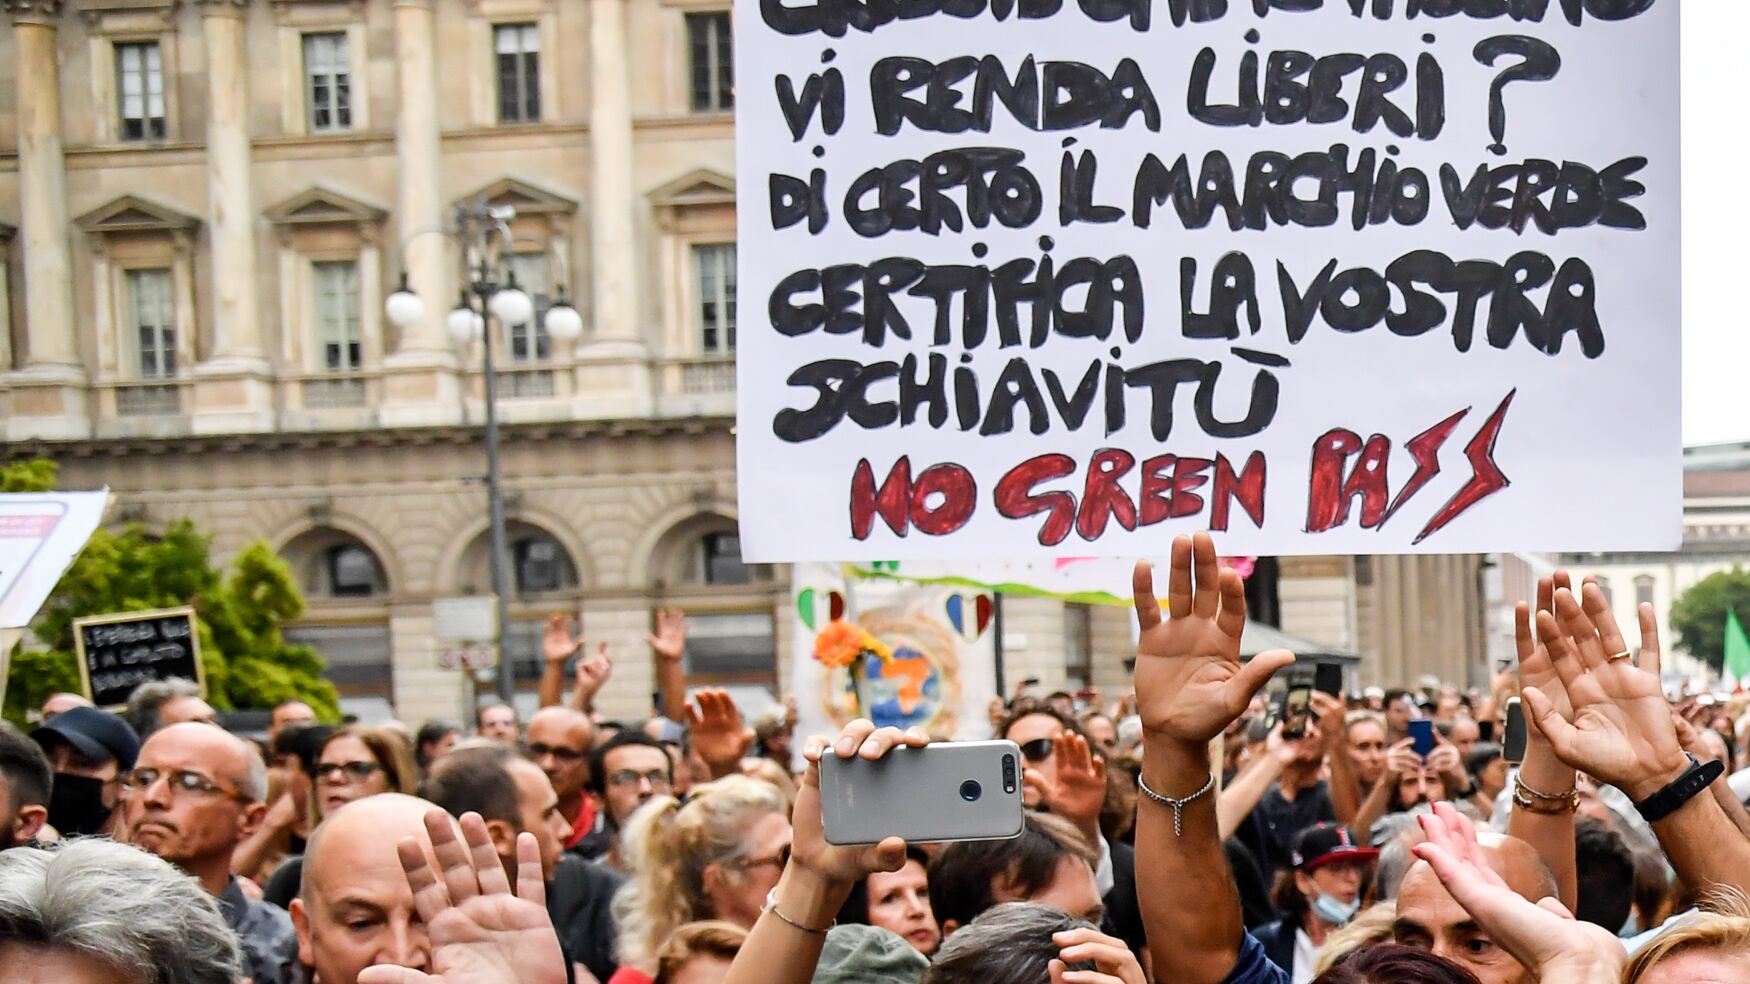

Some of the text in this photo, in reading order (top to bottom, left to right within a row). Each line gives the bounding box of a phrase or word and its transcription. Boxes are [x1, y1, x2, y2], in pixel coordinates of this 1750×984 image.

[775, 28, 1561, 155] VI RENDA LIBERI ?
[769, 136, 1649, 237] DI CERTO IL MARCHIO VERDE
[768, 235, 1605, 359] CERTIFICA LA VOSTRA
[850, 386, 1517, 546] NO GREEN PASS
